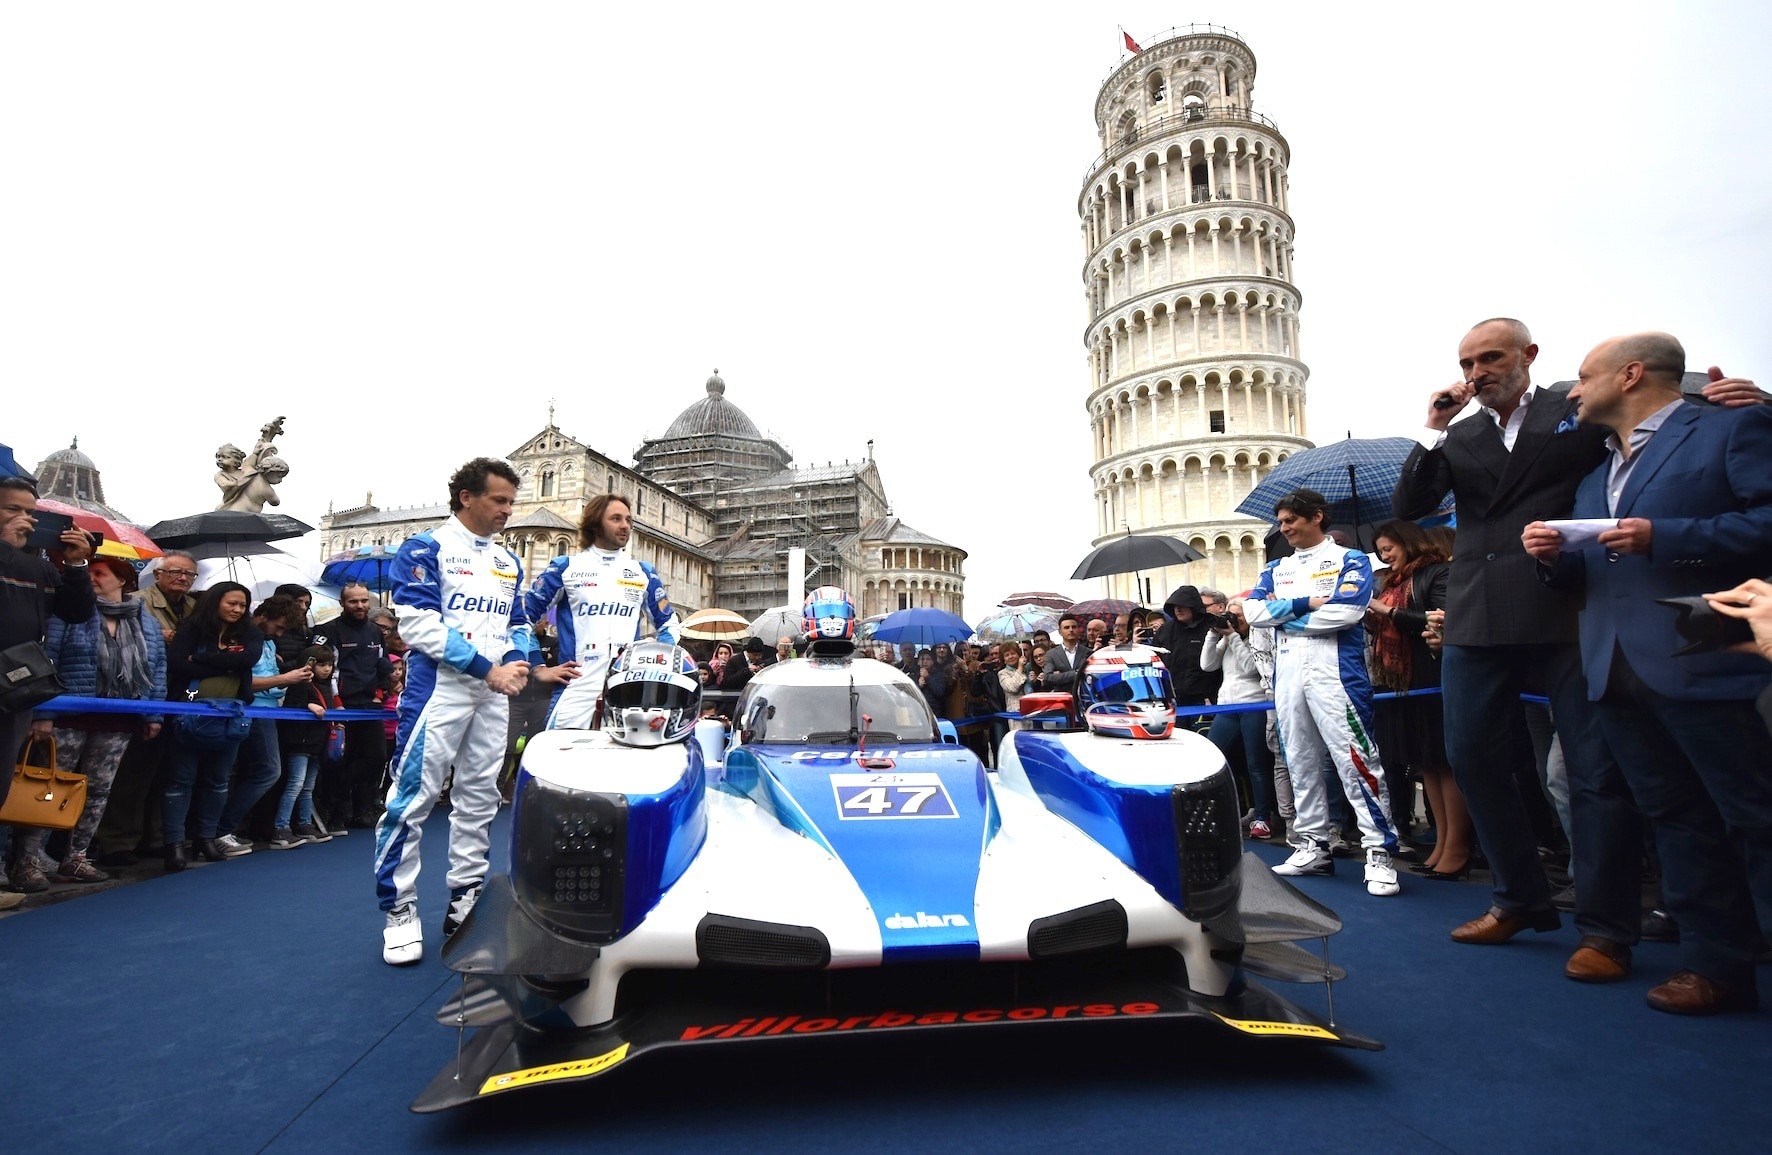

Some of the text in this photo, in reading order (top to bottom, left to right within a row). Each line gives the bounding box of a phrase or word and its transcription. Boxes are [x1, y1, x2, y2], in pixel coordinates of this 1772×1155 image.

[447, 593, 510, 616] Cetilar
[578, 602, 635, 617] Cetilar
[623, 669, 675, 681] Cetilar
[1121, 667, 1163, 681] Cetilar
[844, 787, 937, 814] 47
